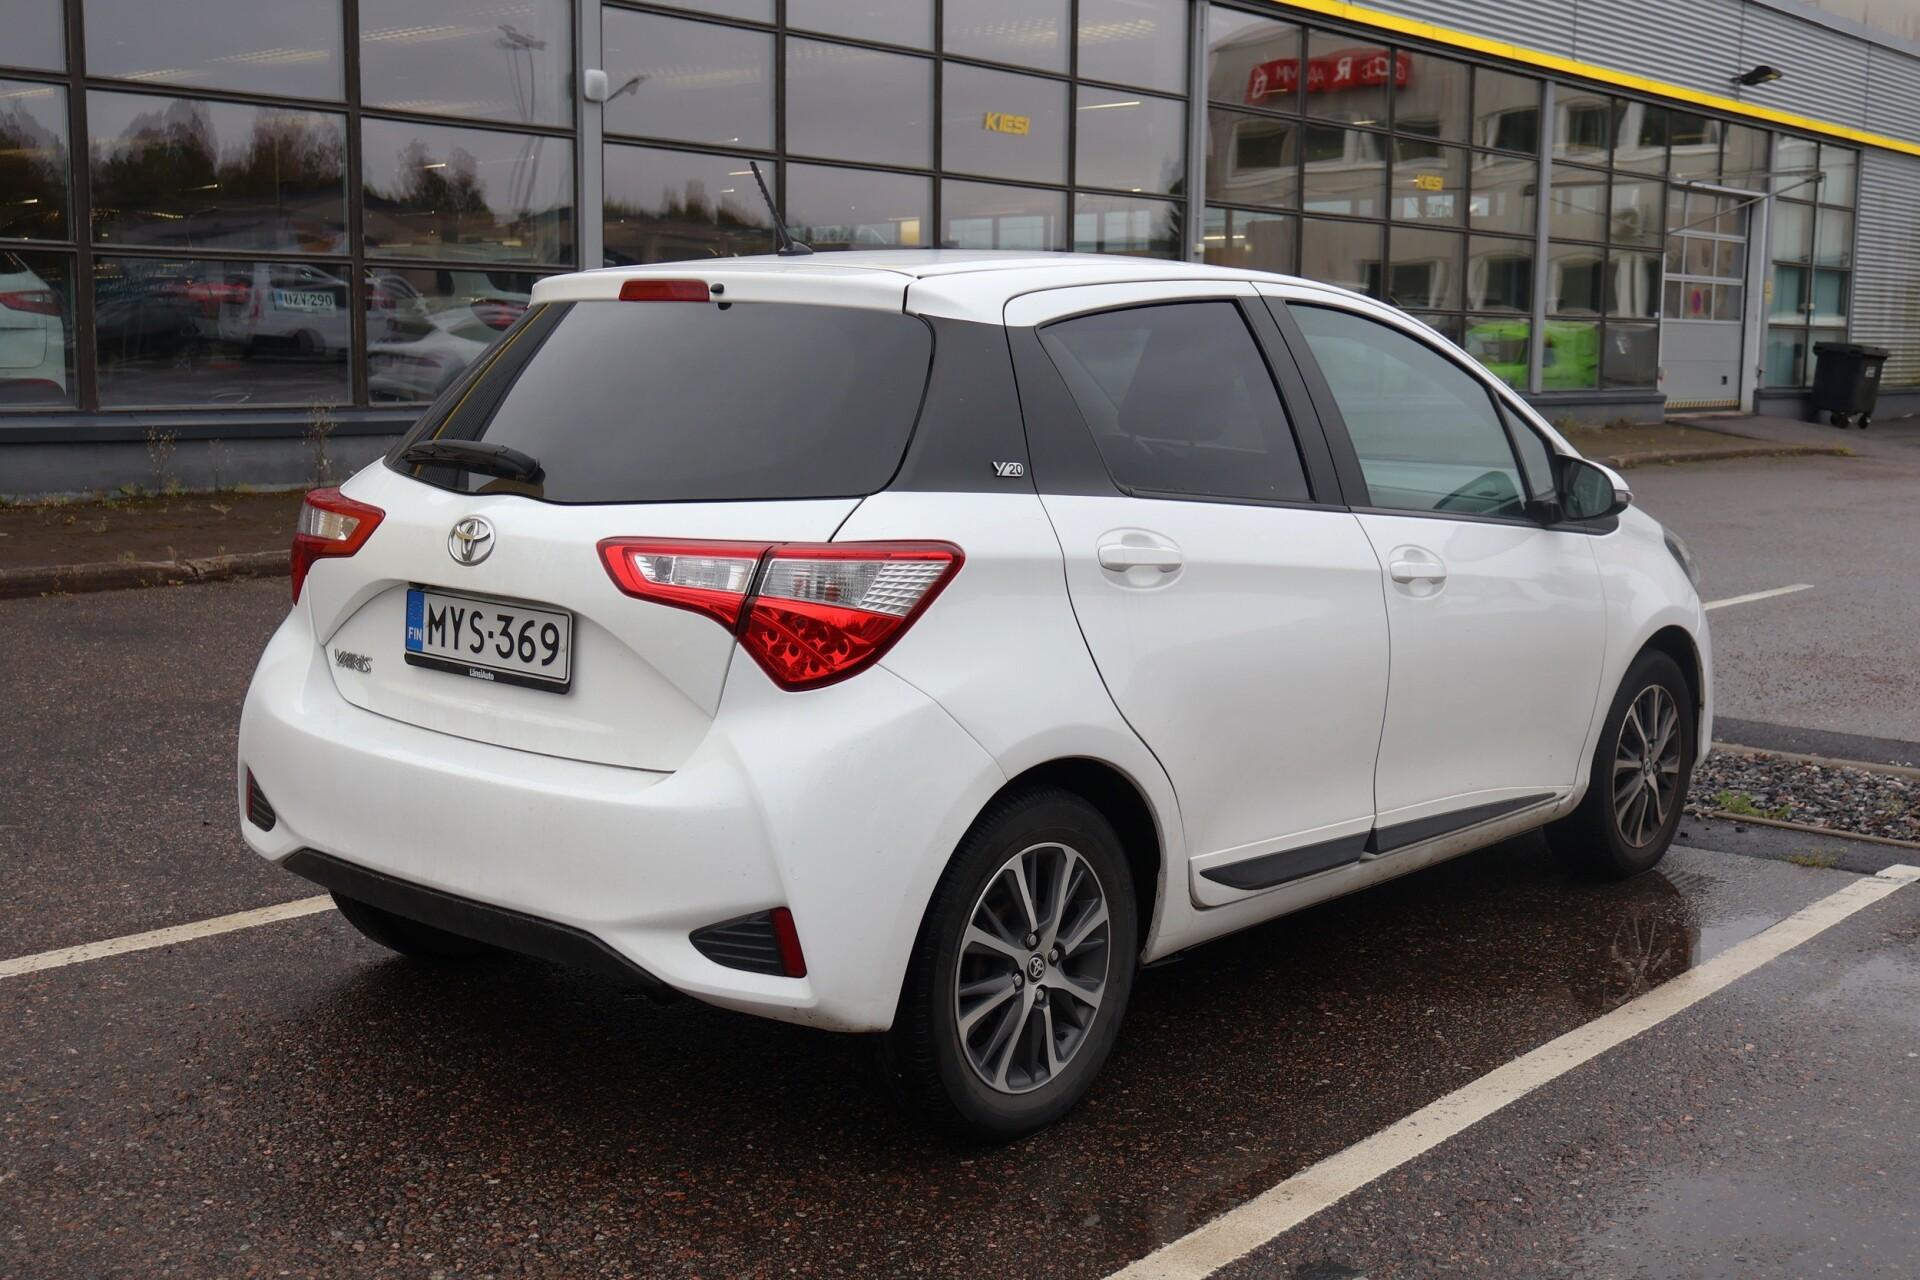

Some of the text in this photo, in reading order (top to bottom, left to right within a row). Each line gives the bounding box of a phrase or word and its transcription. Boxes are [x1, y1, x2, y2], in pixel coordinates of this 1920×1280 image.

[985, 111, 1030, 136] KIESI
[407, 626, 423, 642] FIN
[427, 602, 560, 667] MYS-369
[334, 648, 373, 673] YARIS
